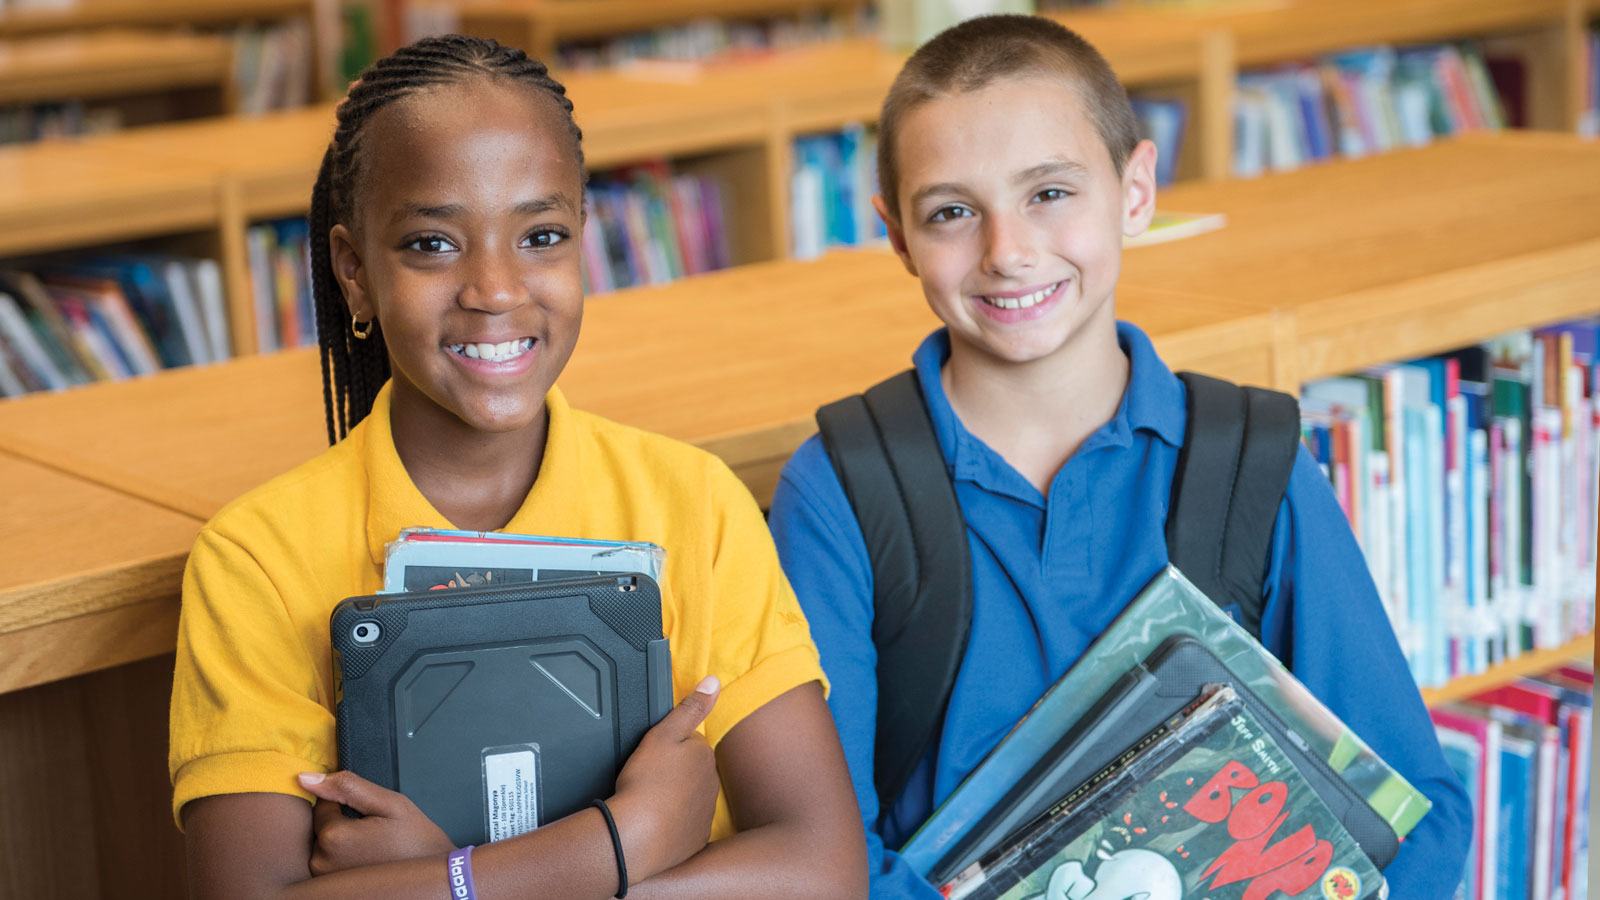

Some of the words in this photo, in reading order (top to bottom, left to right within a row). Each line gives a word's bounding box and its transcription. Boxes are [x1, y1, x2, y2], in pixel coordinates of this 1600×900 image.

[1120, 750, 1136, 764] OF
[1094, 765, 1117, 783] THE
[1050, 785, 1090, 816] STORM
[1183, 760, 1334, 900] BONE
